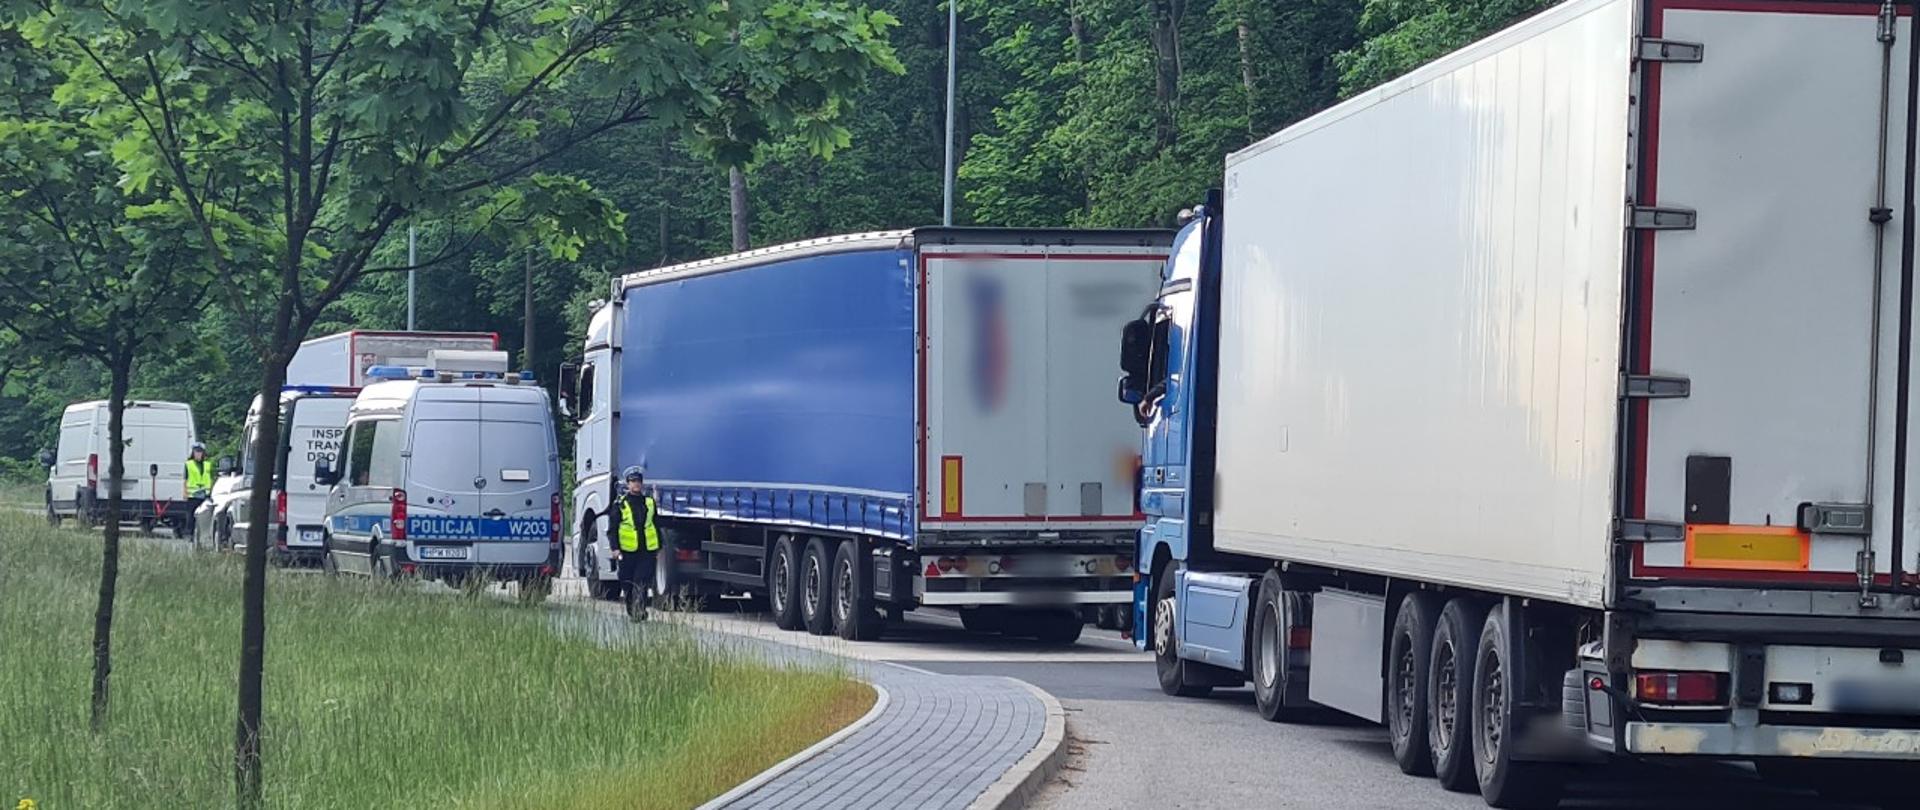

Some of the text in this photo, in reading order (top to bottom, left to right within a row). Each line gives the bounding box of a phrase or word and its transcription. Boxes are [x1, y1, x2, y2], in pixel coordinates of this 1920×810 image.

[312, 429, 343, 439] INSP
[411, 519, 547, 535] POLICJA W203
